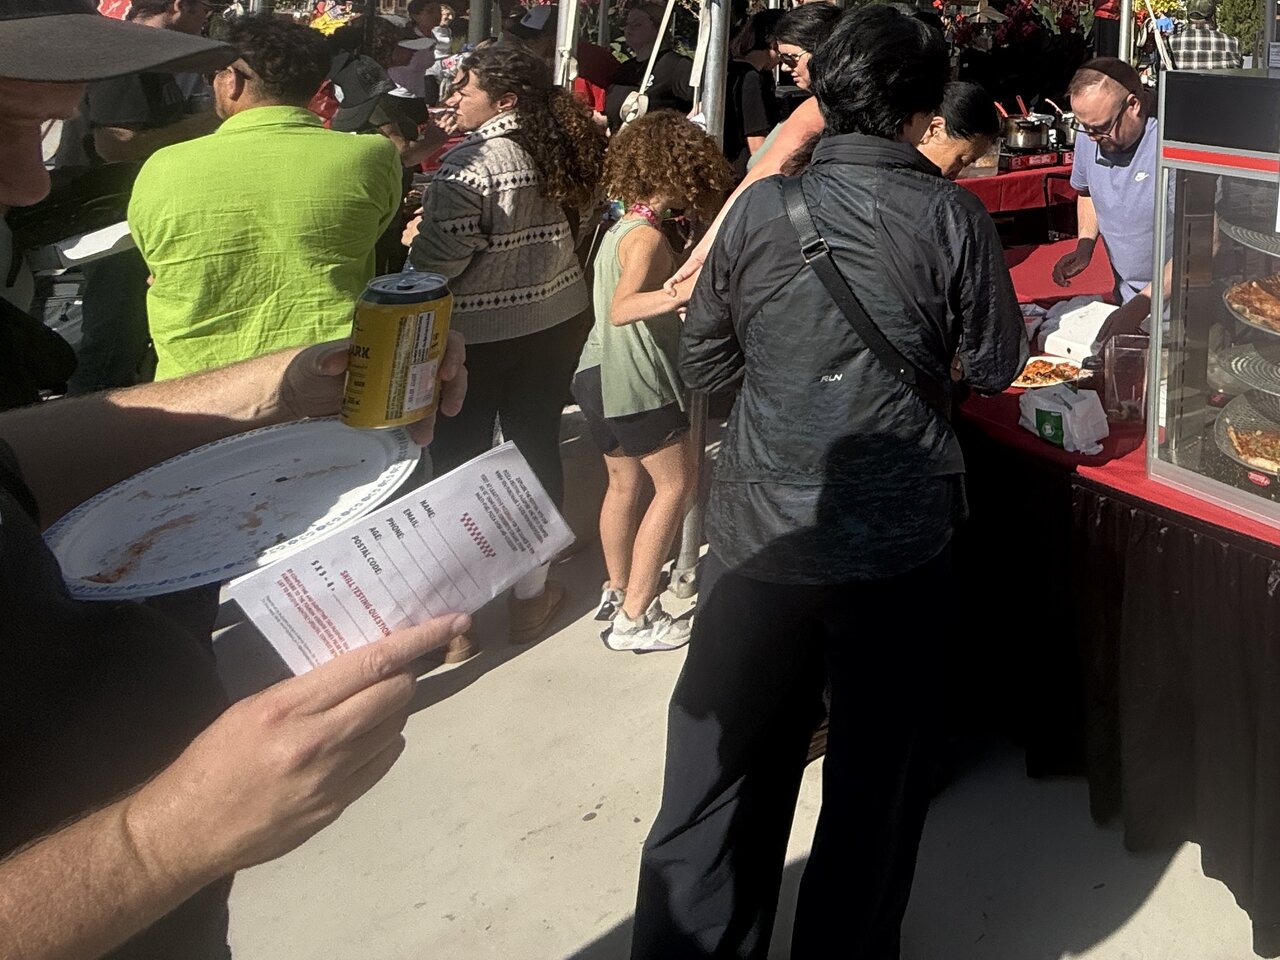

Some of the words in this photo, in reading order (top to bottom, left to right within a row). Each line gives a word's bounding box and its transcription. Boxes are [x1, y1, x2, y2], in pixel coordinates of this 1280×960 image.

[402, 507, 421, 529] EMAIL:
[418, 498, 437, 520] NAME:
[368, 524, 384, 542] AGE:
[385, 516, 406, 541] PHONE:
[351, 534, 372, 559] POSTAL
[366, 556, 384, 576] CODE:
[339, 569, 357, 588] SKILL
[351, 585, 373, 611] TESTING
[367, 606, 394, 639] QUESTION
